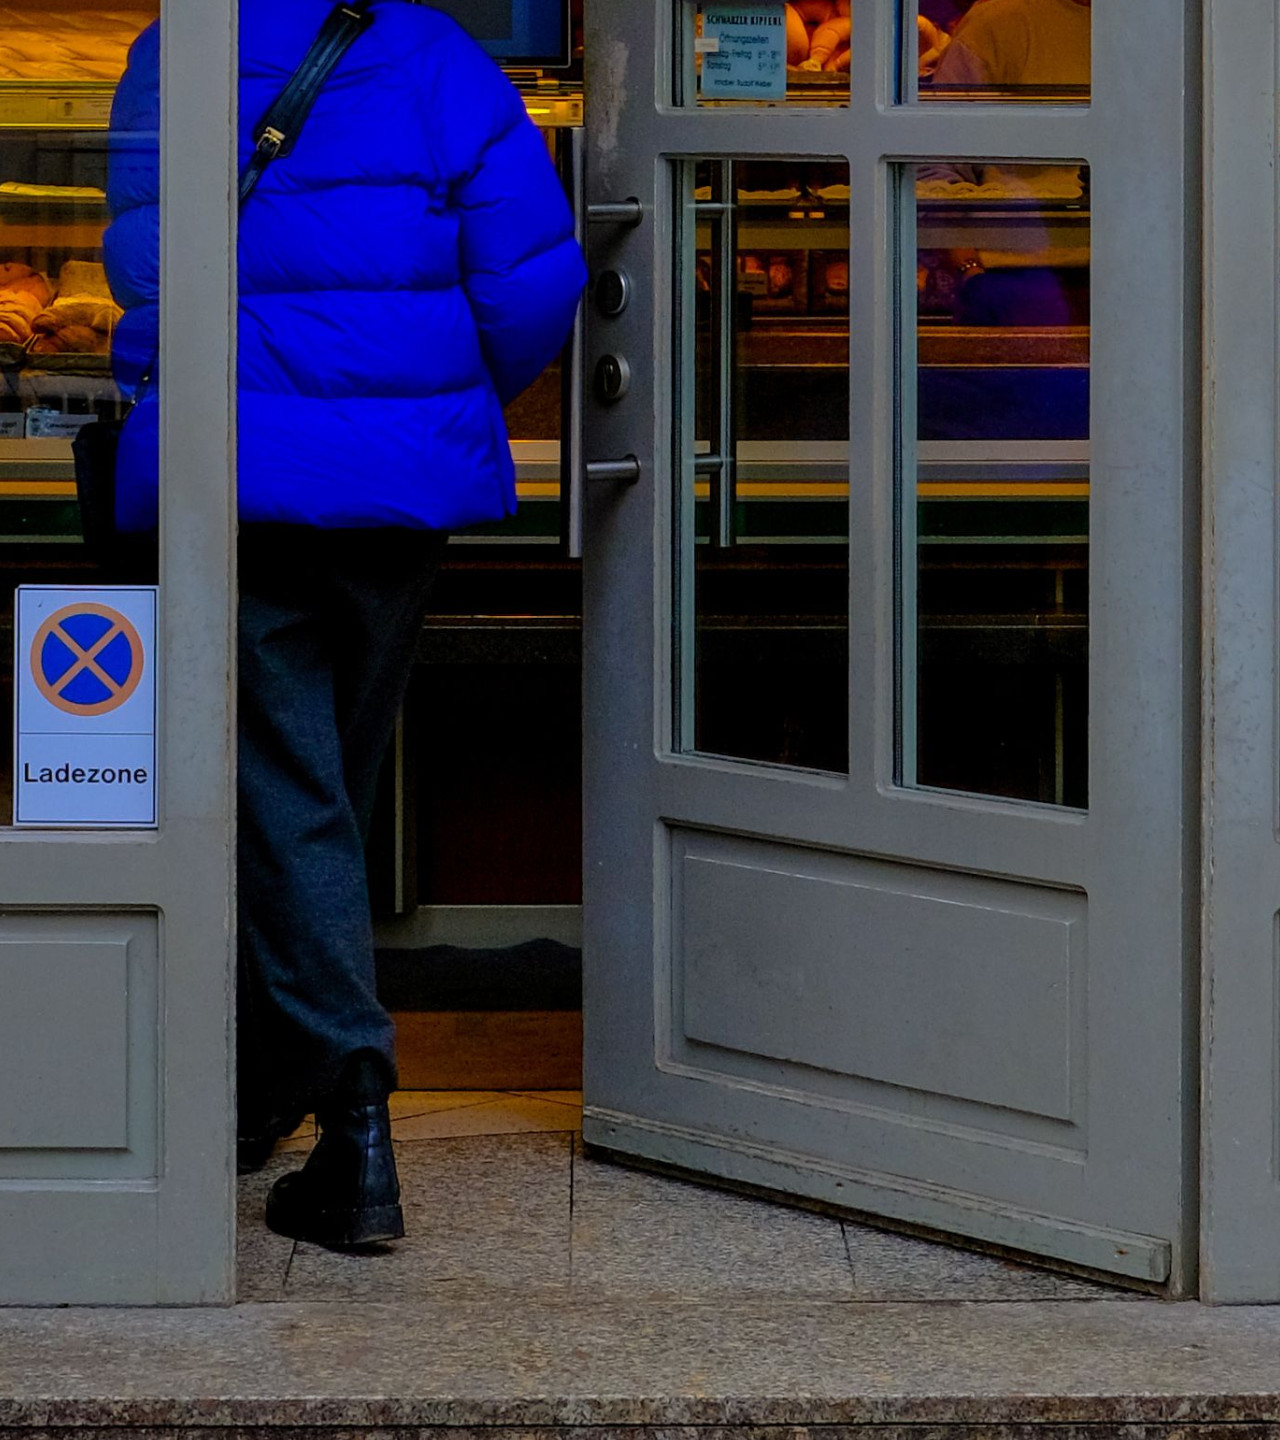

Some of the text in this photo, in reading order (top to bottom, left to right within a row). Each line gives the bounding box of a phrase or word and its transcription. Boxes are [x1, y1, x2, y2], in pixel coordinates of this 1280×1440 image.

[706, 15, 782, 26] SCHWARZER KIPFERL
[23, 761, 148, 784] Ladezone
